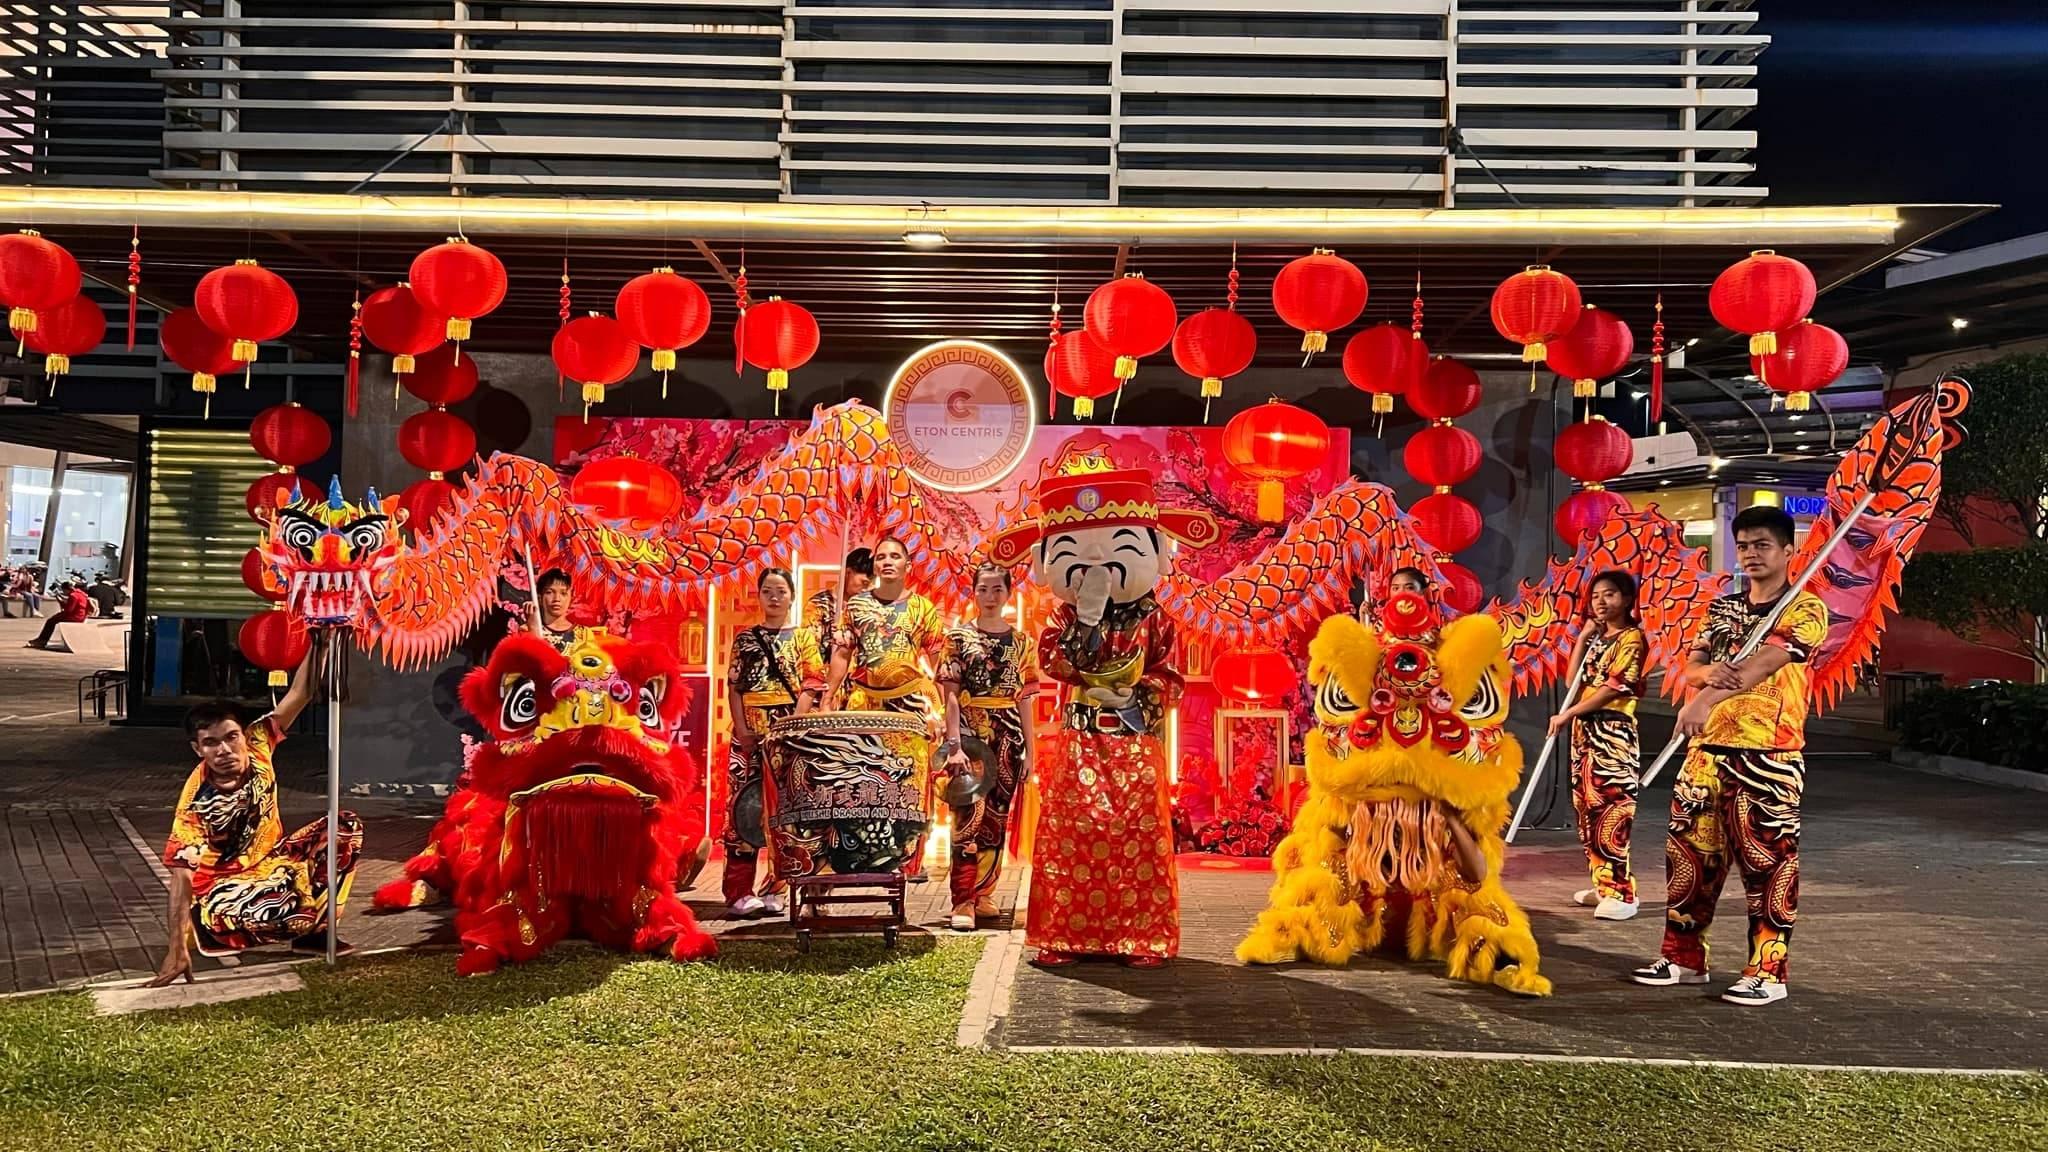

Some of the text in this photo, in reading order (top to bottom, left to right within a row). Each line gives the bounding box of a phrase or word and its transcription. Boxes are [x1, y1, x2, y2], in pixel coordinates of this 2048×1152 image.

[914, 426, 1004, 438] ETON CENTRIS
[1000, 645, 1019, 689] 尾生
[832, 807, 870, 819] DRAGON
[871, 807, 889, 819] AND
